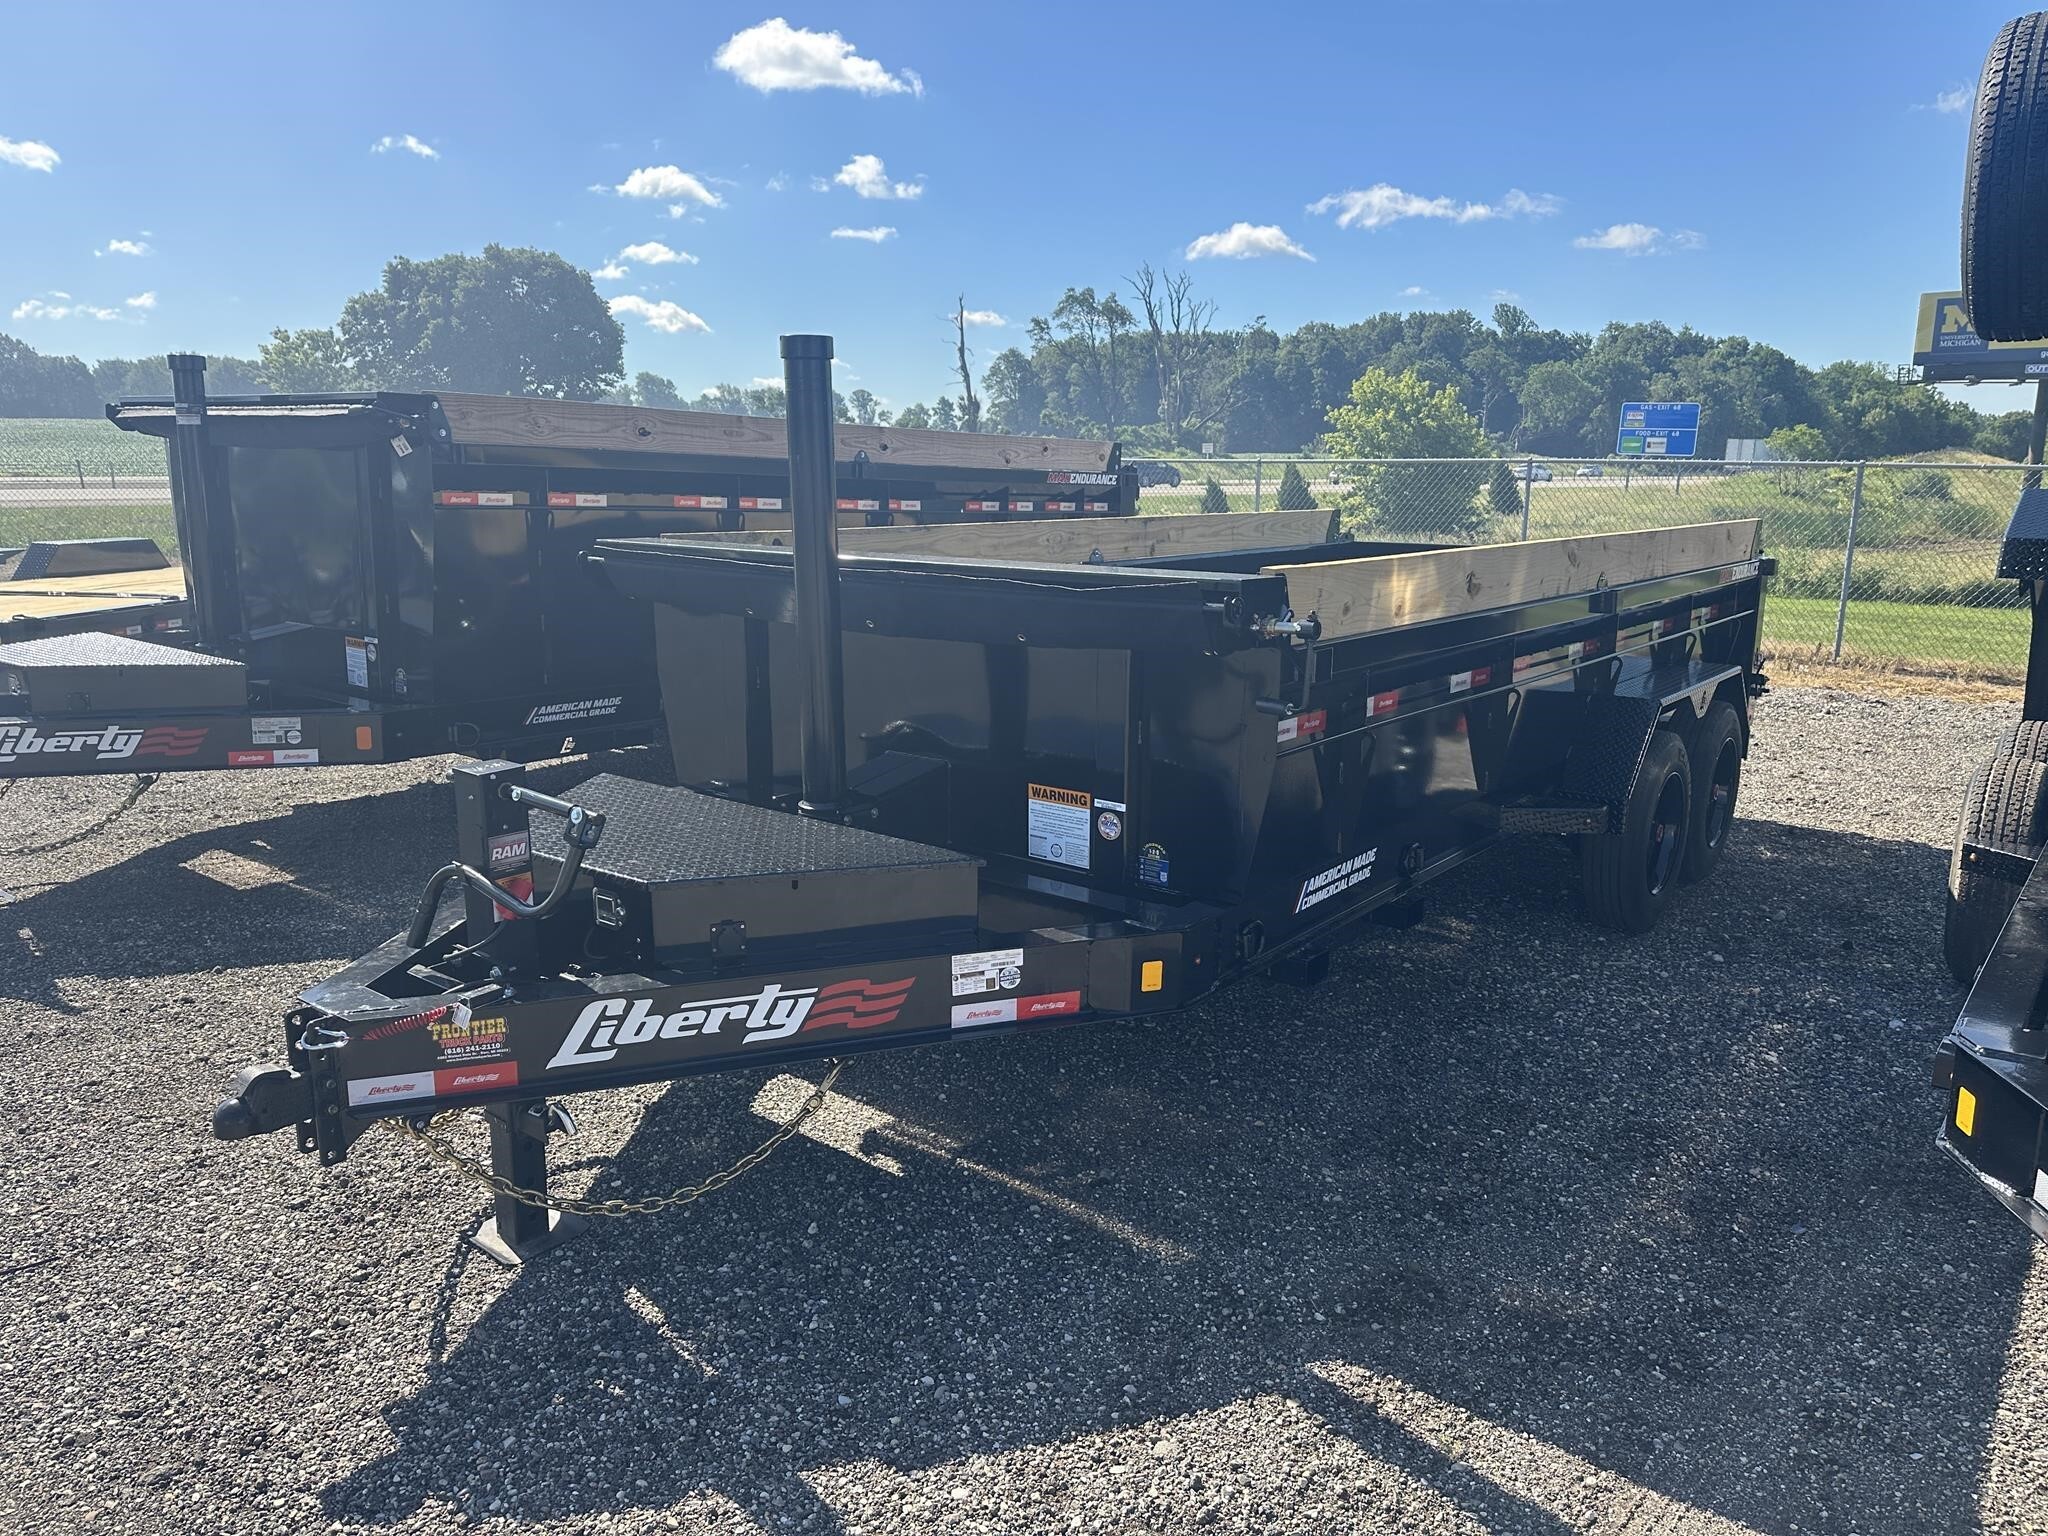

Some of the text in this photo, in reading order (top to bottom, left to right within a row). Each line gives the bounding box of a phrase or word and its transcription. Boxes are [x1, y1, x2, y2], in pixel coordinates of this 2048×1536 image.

[1940, 339, 1981, 347] MICHIGAN
[532, 706, 616, 724] COMMERCIAL GRADE
[538, 696, 622, 715] AMERICAN MADE
[1031, 786, 1088, 807] WARNING
[492, 842, 527, 861] RAM
[1307, 847, 1378, 894] AMERICAN MADE
[1301, 865, 1372, 910] COMMERCIAL GRADE
[432, 1017, 506, 1040] FRONTIER
[545, 984, 819, 1070] Liberty
[439, 1033, 503, 1048] TRUCK PARTS
[466, 1042, 501, 1052] 241-2110
[453, 1074, 486, 1086] Liberty
[368, 1084, 402, 1096] Liberty
